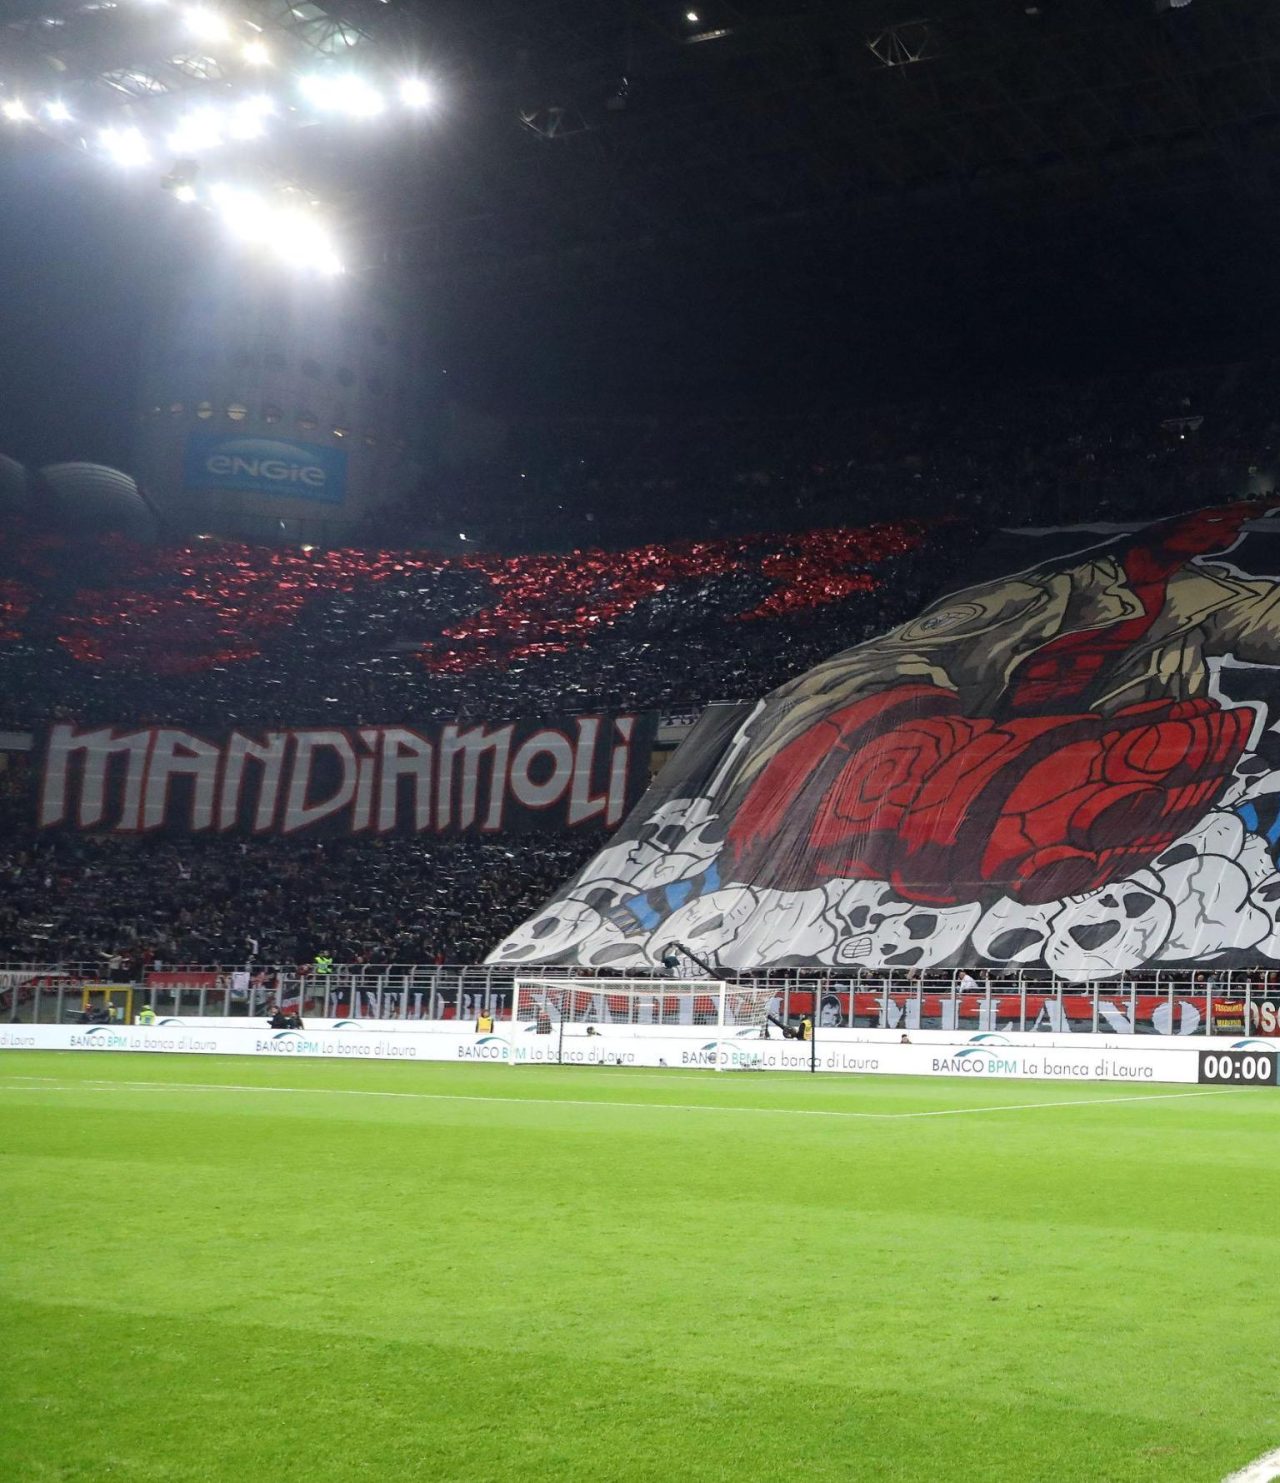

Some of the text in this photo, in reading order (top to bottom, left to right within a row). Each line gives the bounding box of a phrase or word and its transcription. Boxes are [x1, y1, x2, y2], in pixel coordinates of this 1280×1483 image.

[70, 1036, 105, 1047] BANCO
[107, 1036, 128, 1048] BPM
[256, 1040, 295, 1053] BANCO
[297, 1041, 319, 1053] BPM
[458, 1046, 500, 1058] BANCO
[502, 1047, 527, 1060] BM
[932, 1058, 984, 1073] BANCO
[988, 1059, 1017, 1074] BPM
[1043, 1057, 1089, 1076] banca
[1204, 1055, 1271, 1080] 00:00
